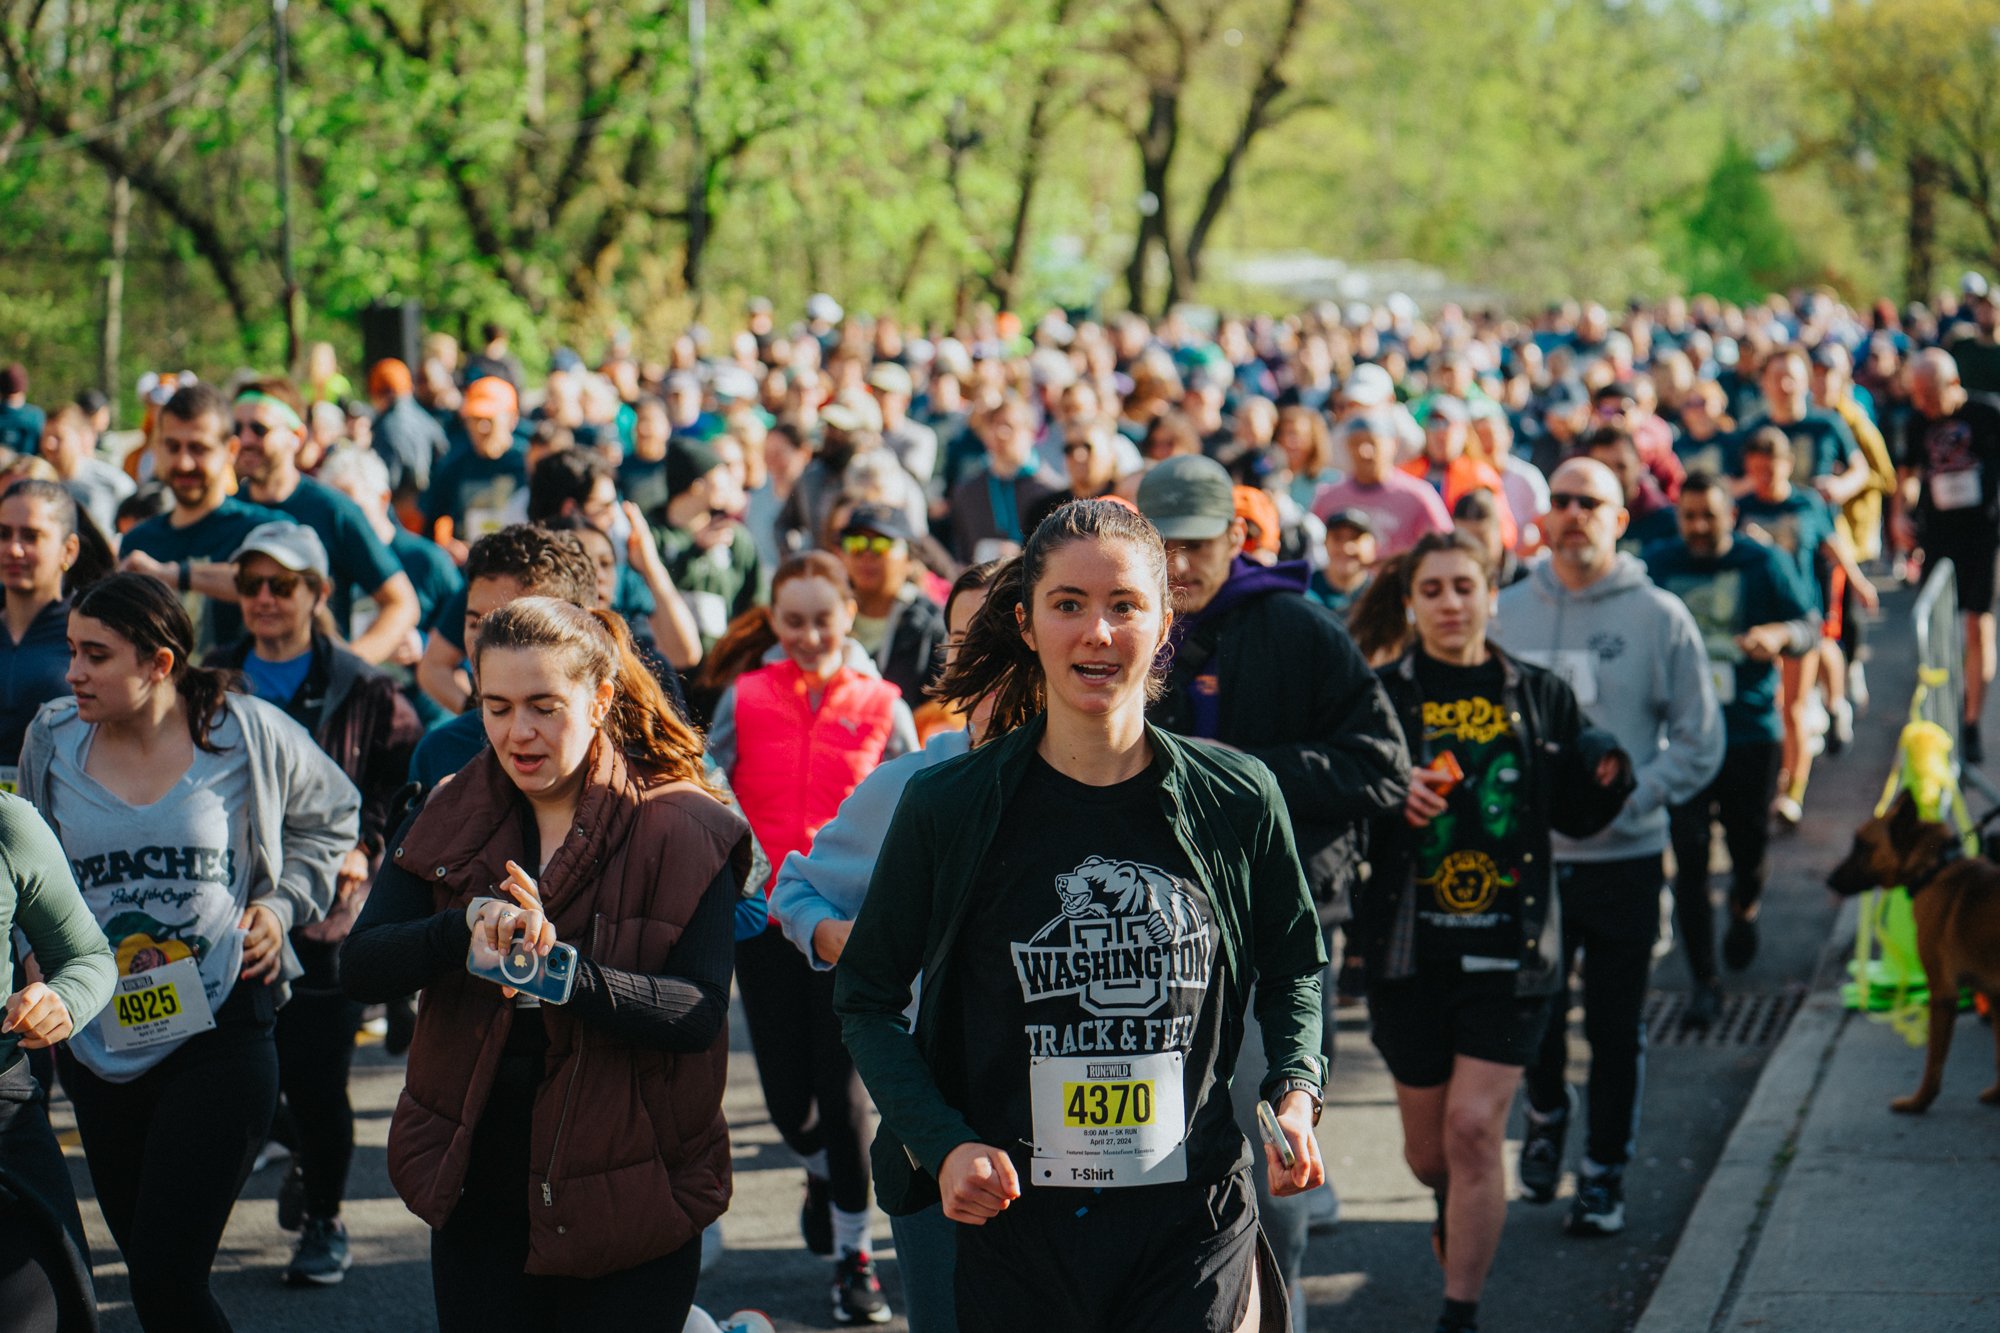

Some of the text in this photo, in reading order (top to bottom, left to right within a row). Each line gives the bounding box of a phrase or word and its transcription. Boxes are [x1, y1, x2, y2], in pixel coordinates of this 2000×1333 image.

[73, 845, 236, 892] PEACHES
[1018, 934, 1208, 995] WASHINGTON
[119, 985, 177, 1024] 4925
[1024, 1015, 1192, 1056] TRACK & FIEL
[1090, 1064, 1129, 1078] RUN WILD
[1067, 1083, 1150, 1125] 4370
[1090, 1138, 1105, 1146] April
[1117, 1137, 1132, 1145] 2024
[1115, 1128, 1124, 1136] 5K
[1071, 1168, 1114, 1180] T-Shirt
